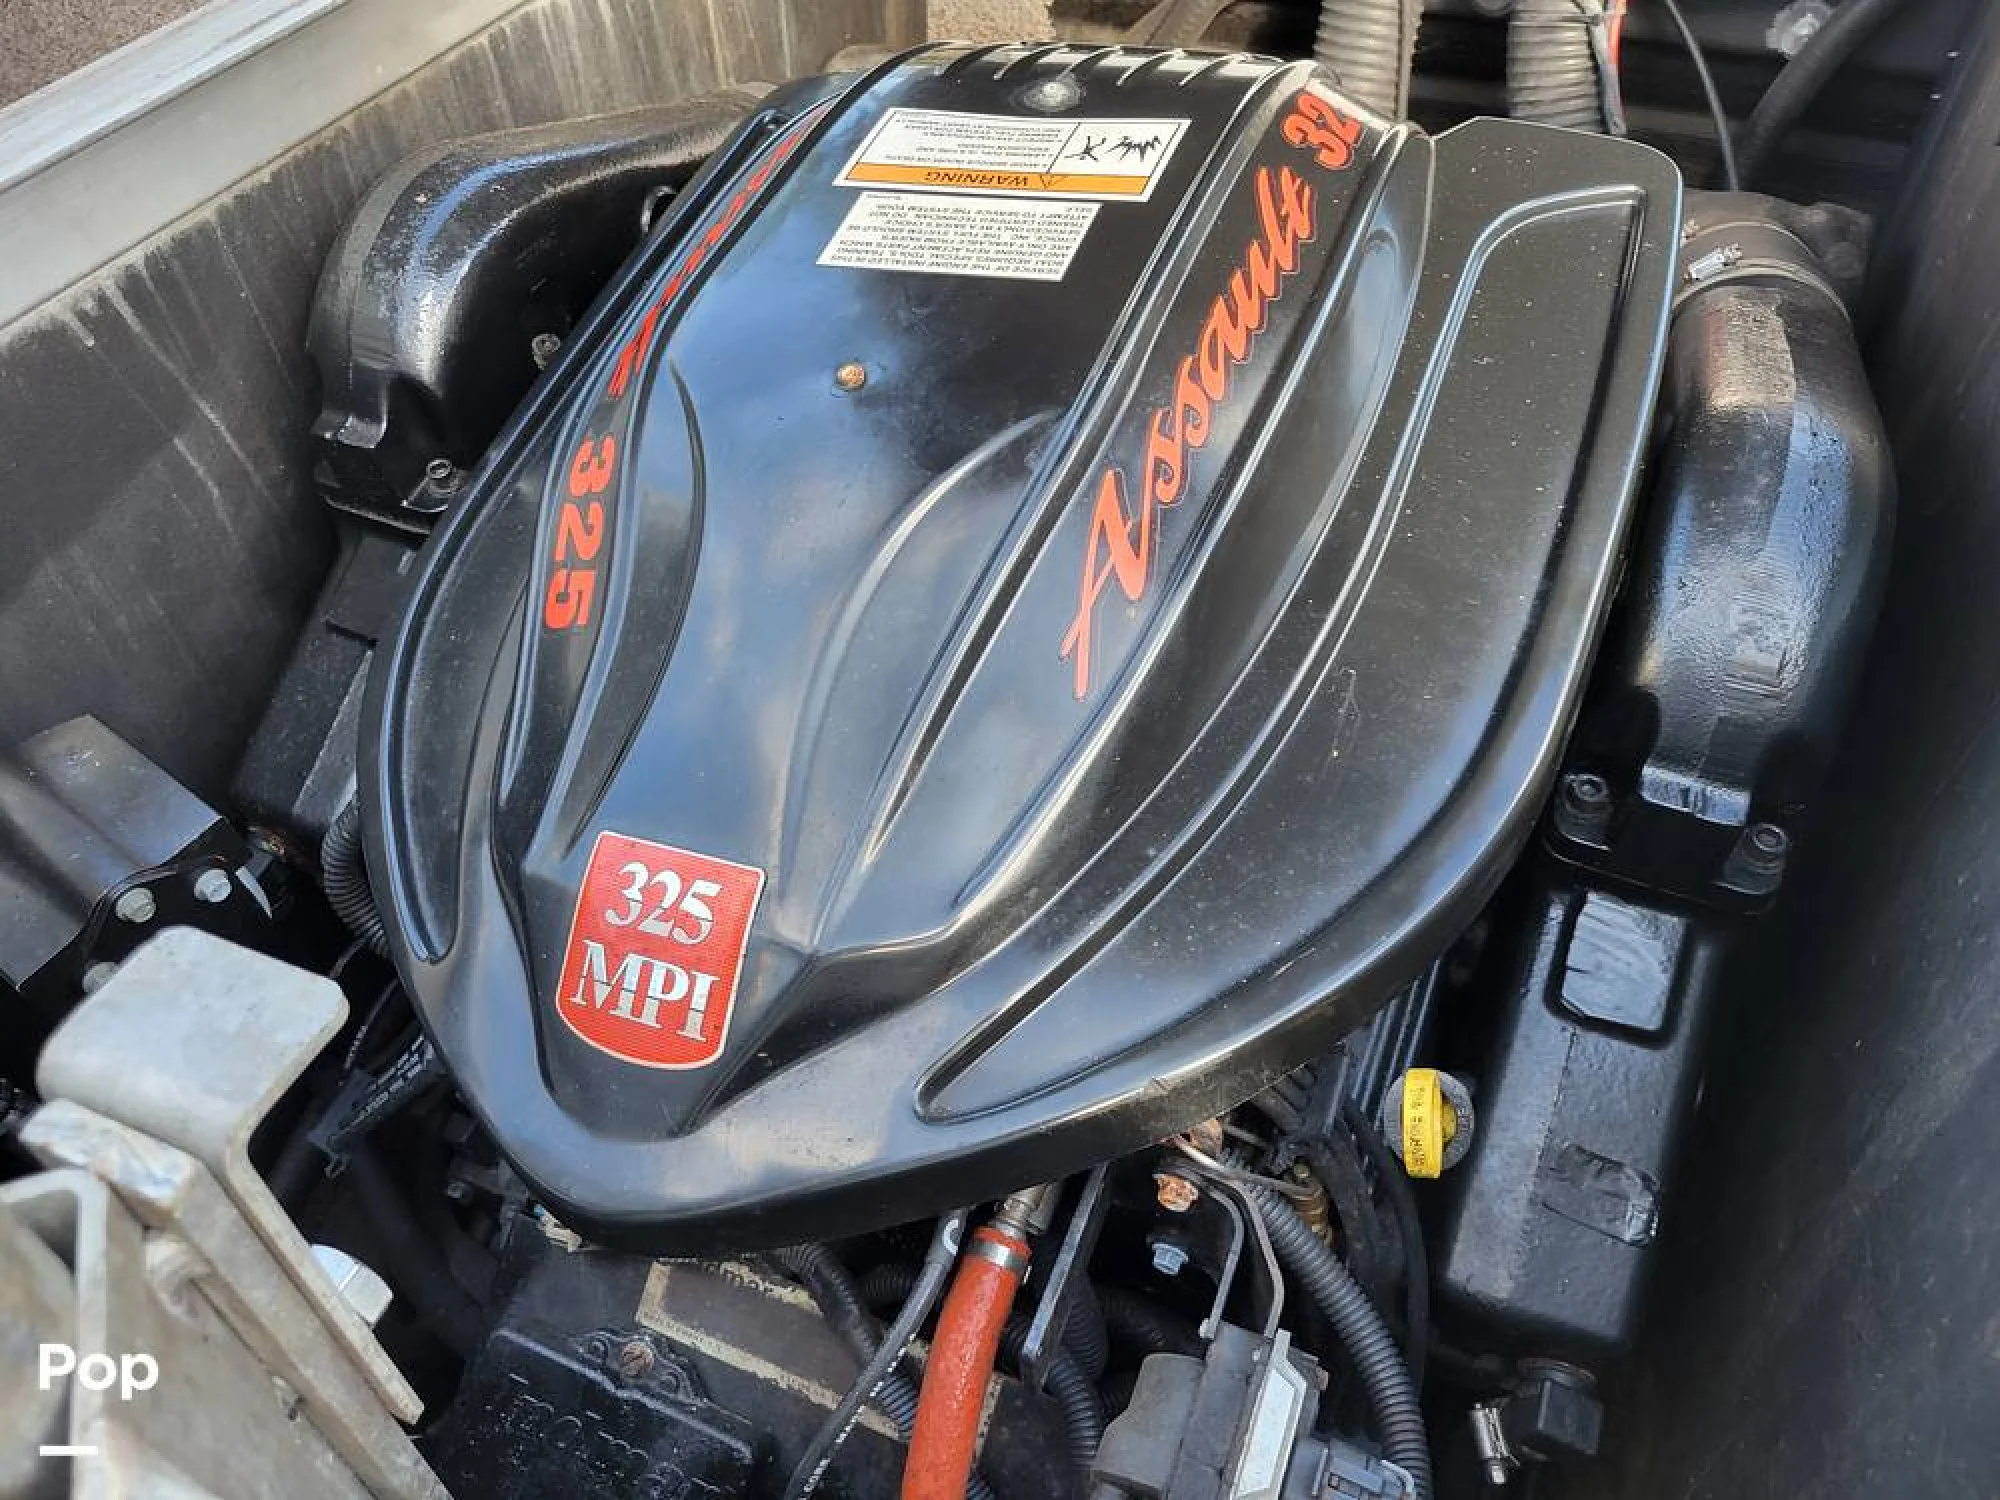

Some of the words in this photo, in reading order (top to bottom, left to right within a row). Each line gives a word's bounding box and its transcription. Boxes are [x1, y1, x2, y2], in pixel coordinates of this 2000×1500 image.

[924, 171, 1029, 186] WARNING
[1012, 266, 1060, 274] SERVICE
[1061, 166, 1315, 702] Assault
[543, 433, 616, 629] 325
[604, 861, 723, 945] 325
[569, 939, 721, 1042] MPI
